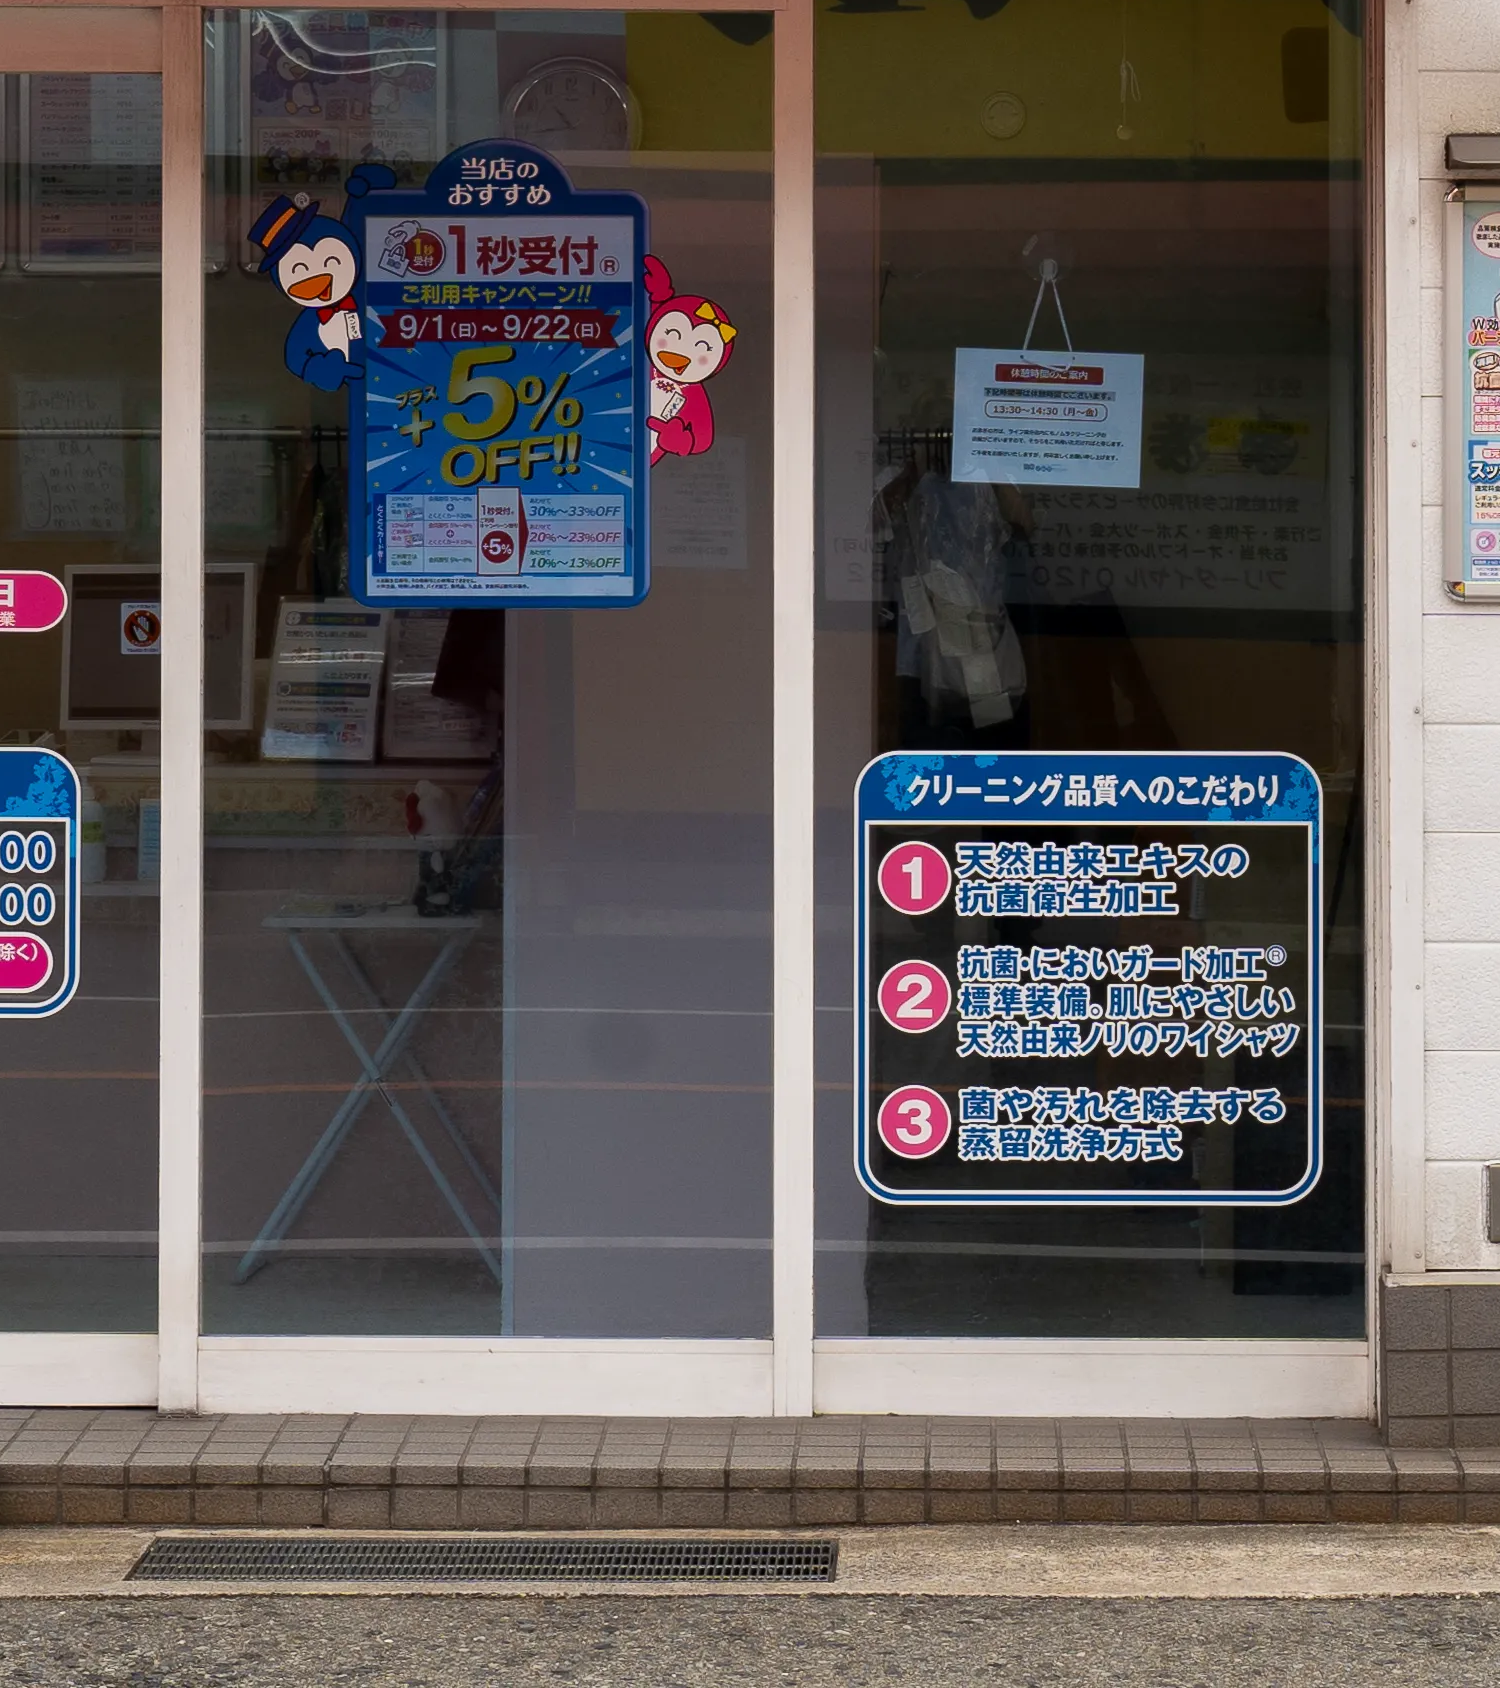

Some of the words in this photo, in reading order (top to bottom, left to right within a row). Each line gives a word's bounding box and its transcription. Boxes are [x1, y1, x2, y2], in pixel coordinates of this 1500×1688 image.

[461, 157, 540, 181] 当店の
[447, 184, 552, 207] おすすめ
[412, 255, 434, 267] 受付
[402, 284, 593, 304] ご利用キャンペーン!!
[1010, 368, 1089, 381] 休憩時間のご案内
[395, 384, 440, 408] プラス
[907, 773, 1280, 808] クリーニング品質へのこだわり
[901, 856, 924, 900] 1
[956, 843, 1250, 878] 天然由来エキスの
[956, 881, 1179, 916] 抗菌衛生加工
[895, 973, 934, 1020] 2
[957, 984, 1296, 1020] 標準装備。肌にやさしい
[956, 1022, 1300, 1058] 天然由来ノリのワイシャツ
[896, 1098, 934, 1145] 3
[957, 1087, 1287, 1124] 菌や汚れを除去する
[957, 1126, 1183, 1162] 蒸留洗浄方式
